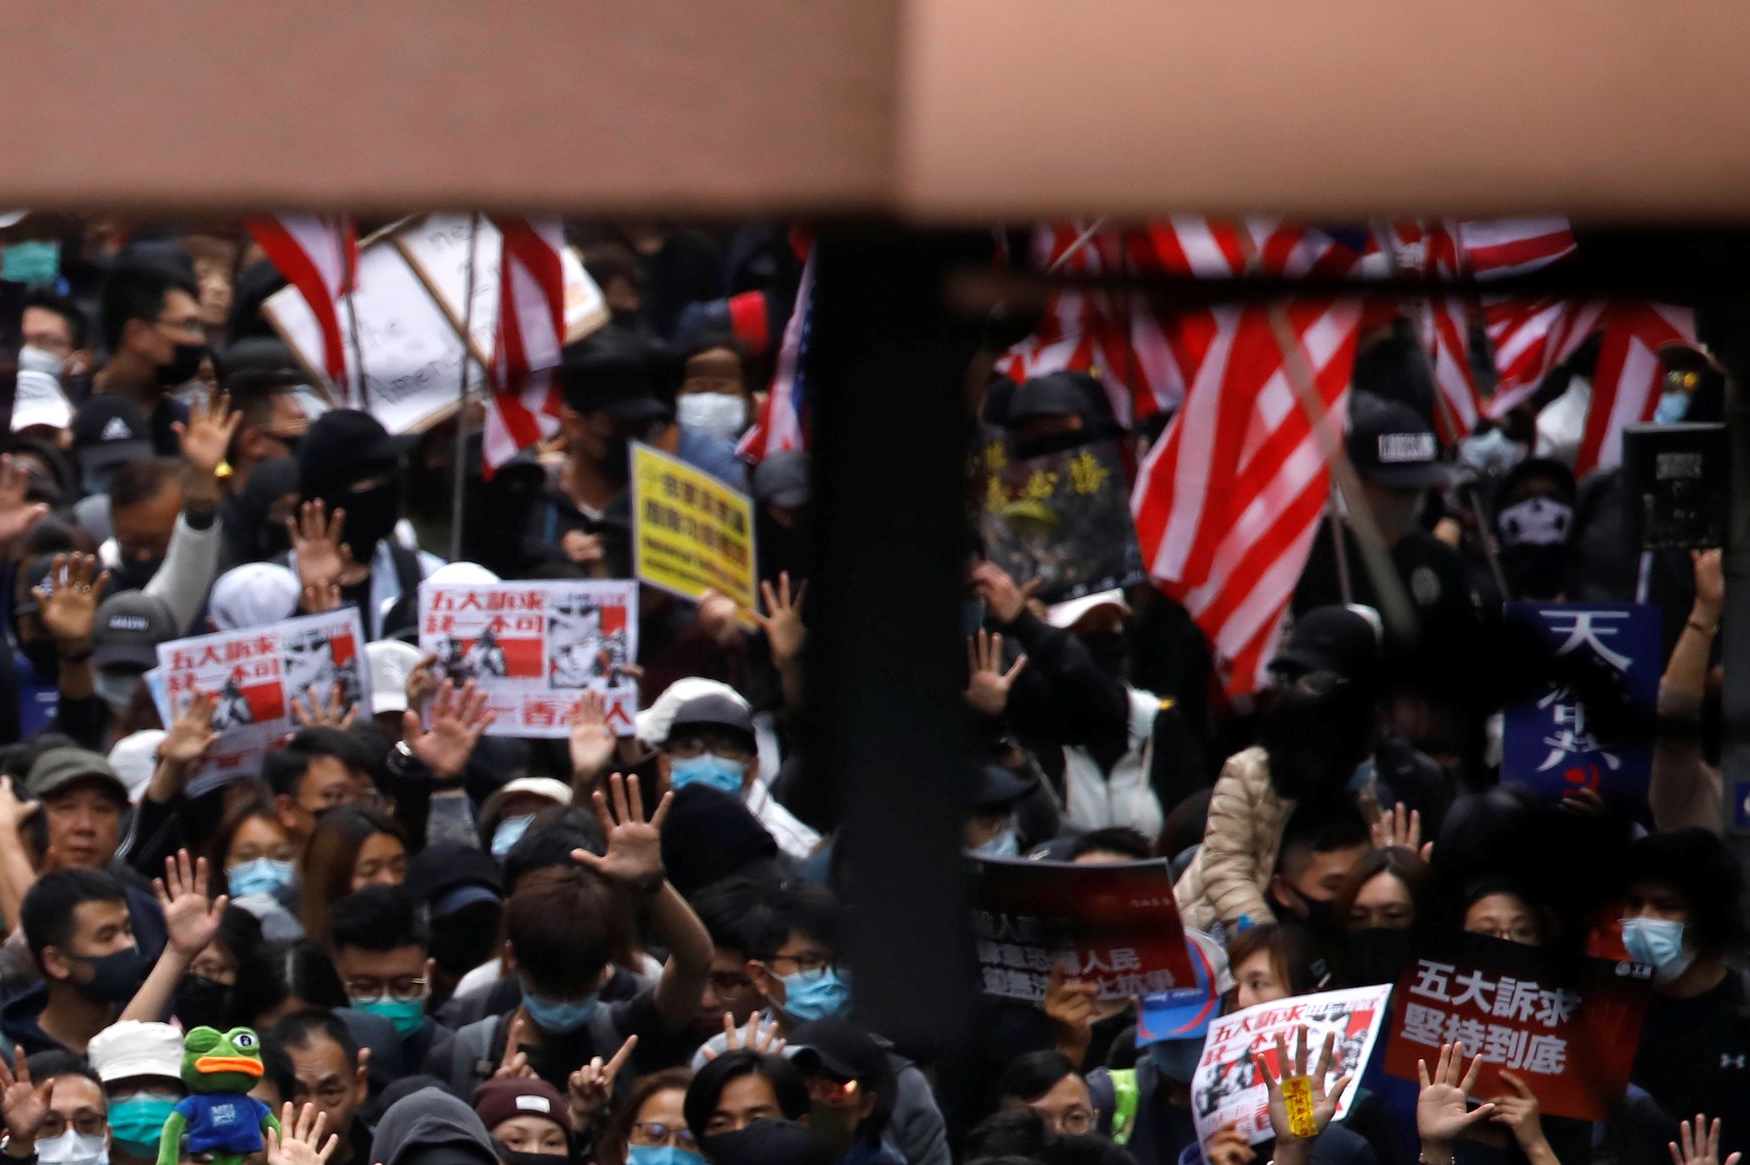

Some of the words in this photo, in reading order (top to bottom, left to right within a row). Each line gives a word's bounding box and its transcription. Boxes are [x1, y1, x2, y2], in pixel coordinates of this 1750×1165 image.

[1410, 959, 1582, 1028] 五大訴求
[1401, 1002, 1567, 1076] 堅持到底
